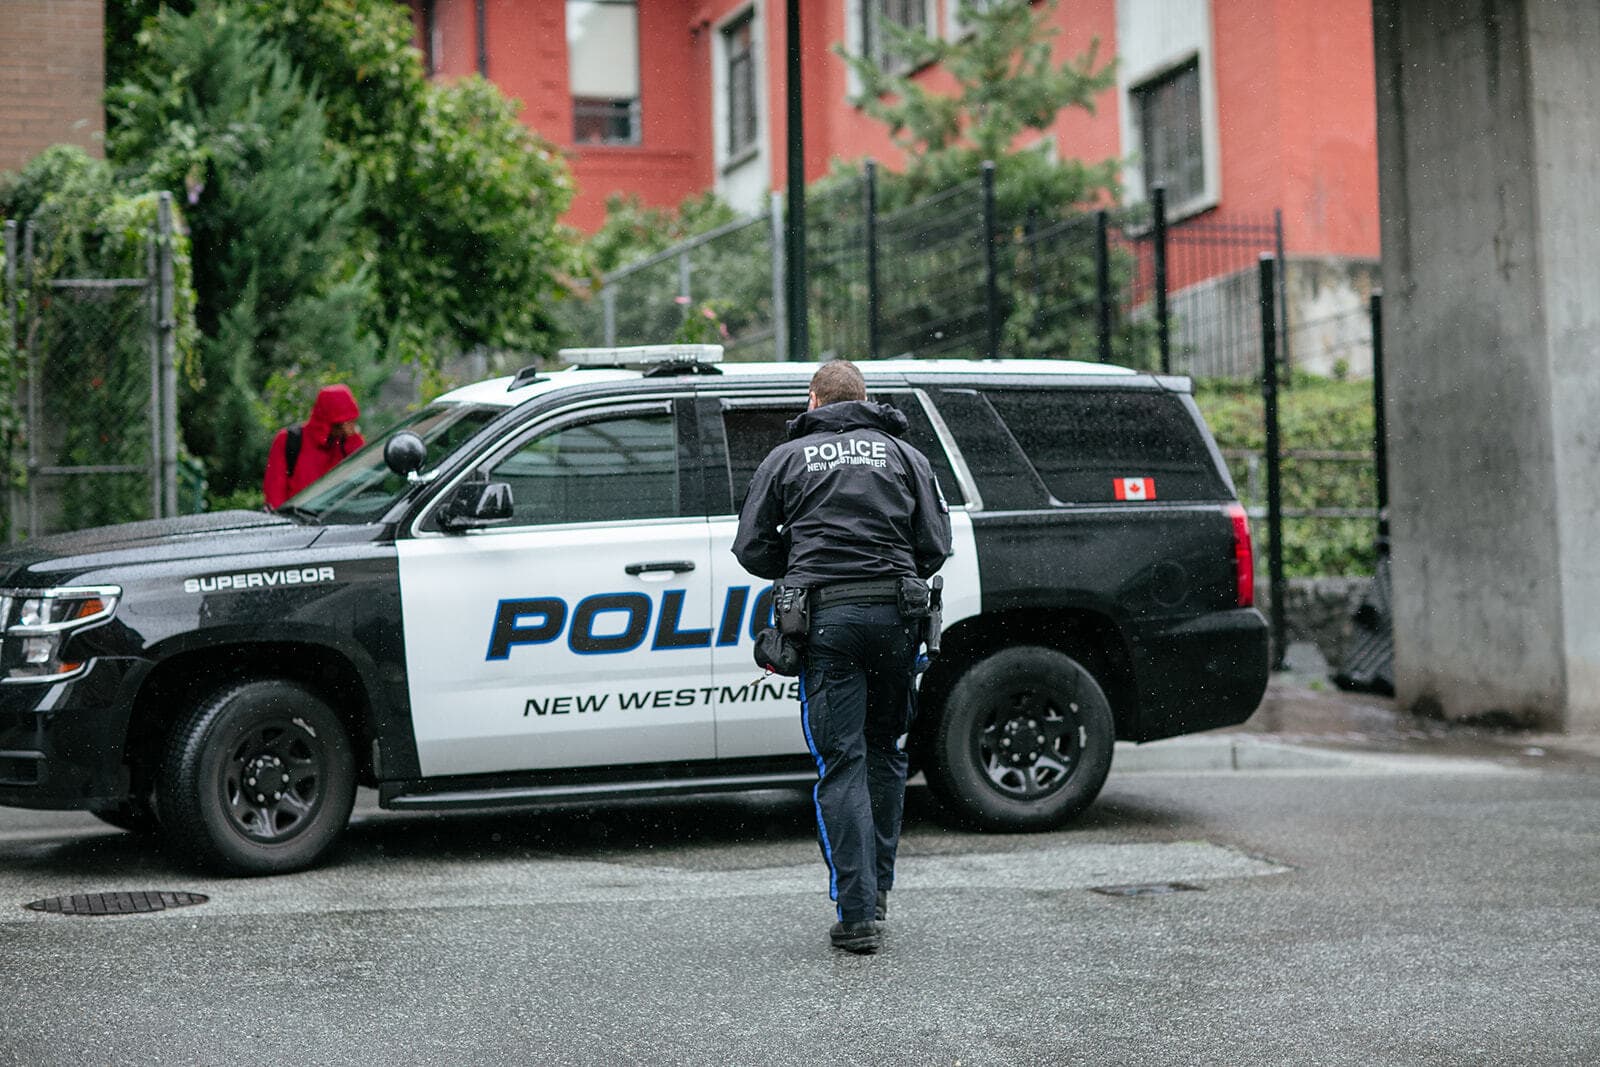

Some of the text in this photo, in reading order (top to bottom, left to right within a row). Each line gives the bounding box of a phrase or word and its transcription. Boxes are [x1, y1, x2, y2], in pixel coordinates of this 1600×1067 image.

[804, 439, 886, 463] POLICE
[807, 462, 827, 472] NEW
[184, 567, 335, 593] SUPERVISOR
[524, 694, 609, 717] NEW
